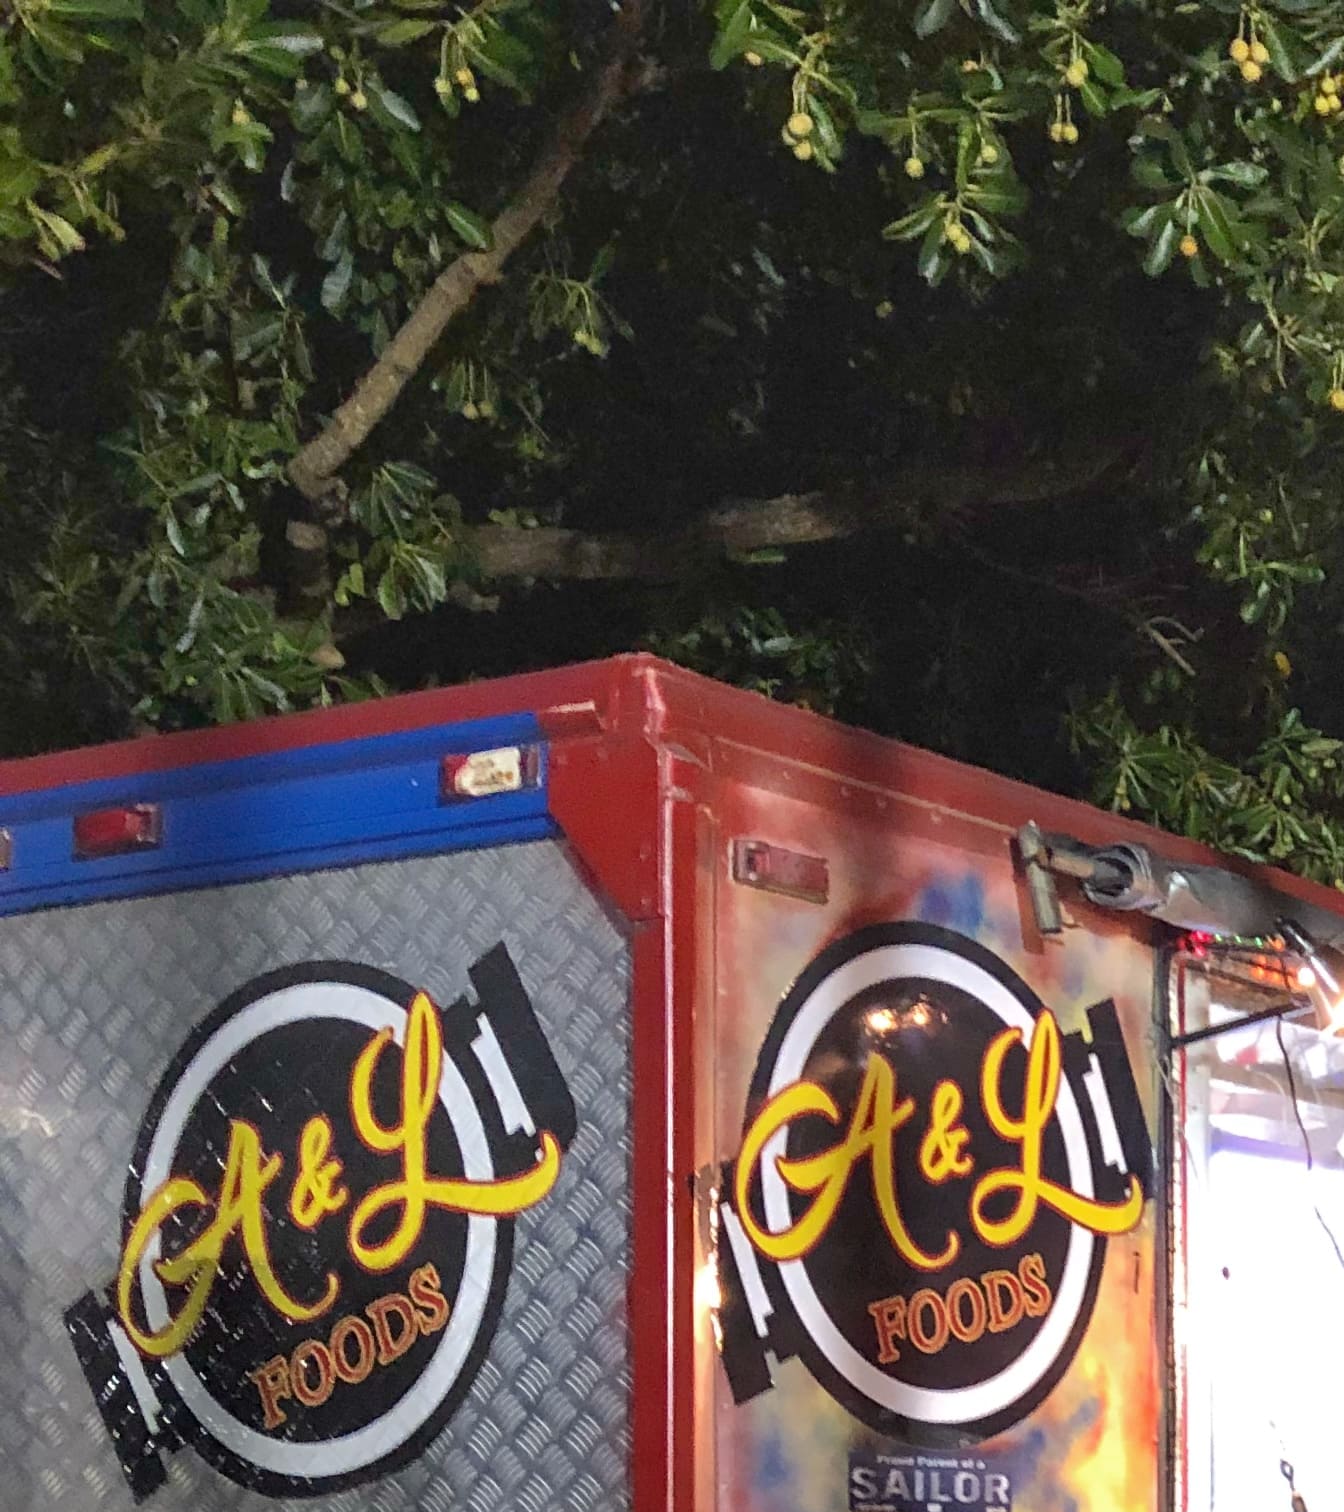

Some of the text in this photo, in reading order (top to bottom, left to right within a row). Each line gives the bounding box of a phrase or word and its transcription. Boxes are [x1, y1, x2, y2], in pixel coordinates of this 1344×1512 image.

[251, 1262, 450, 1430] FOODS
[868, 1252, 1054, 1364] FOODS
[851, 1466, 1010, 1503] SAILOR
